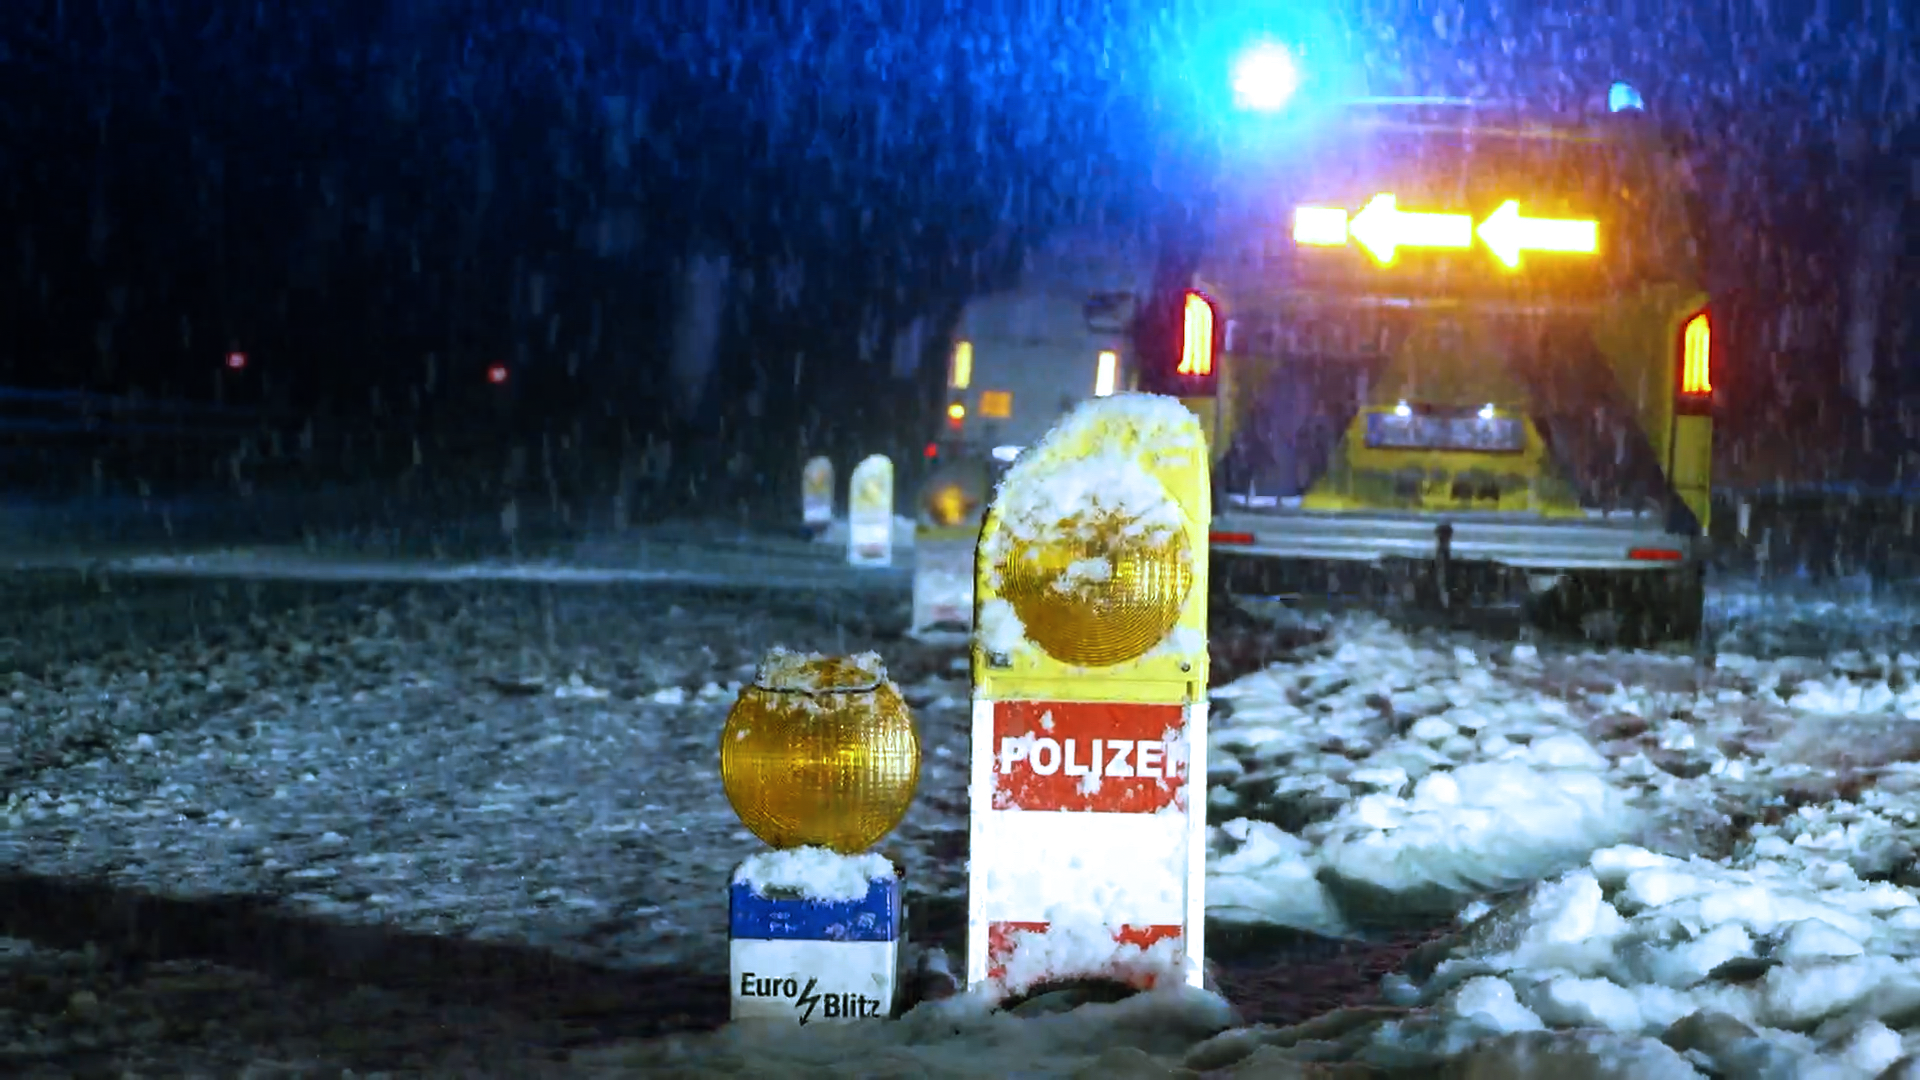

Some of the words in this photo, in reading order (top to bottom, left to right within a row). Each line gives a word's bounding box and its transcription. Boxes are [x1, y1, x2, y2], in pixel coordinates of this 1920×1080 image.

[1000, 736, 1177, 778] POLIZEI
[741, 972, 798, 998] Euro
[824, 992, 880, 1018] Blitz
